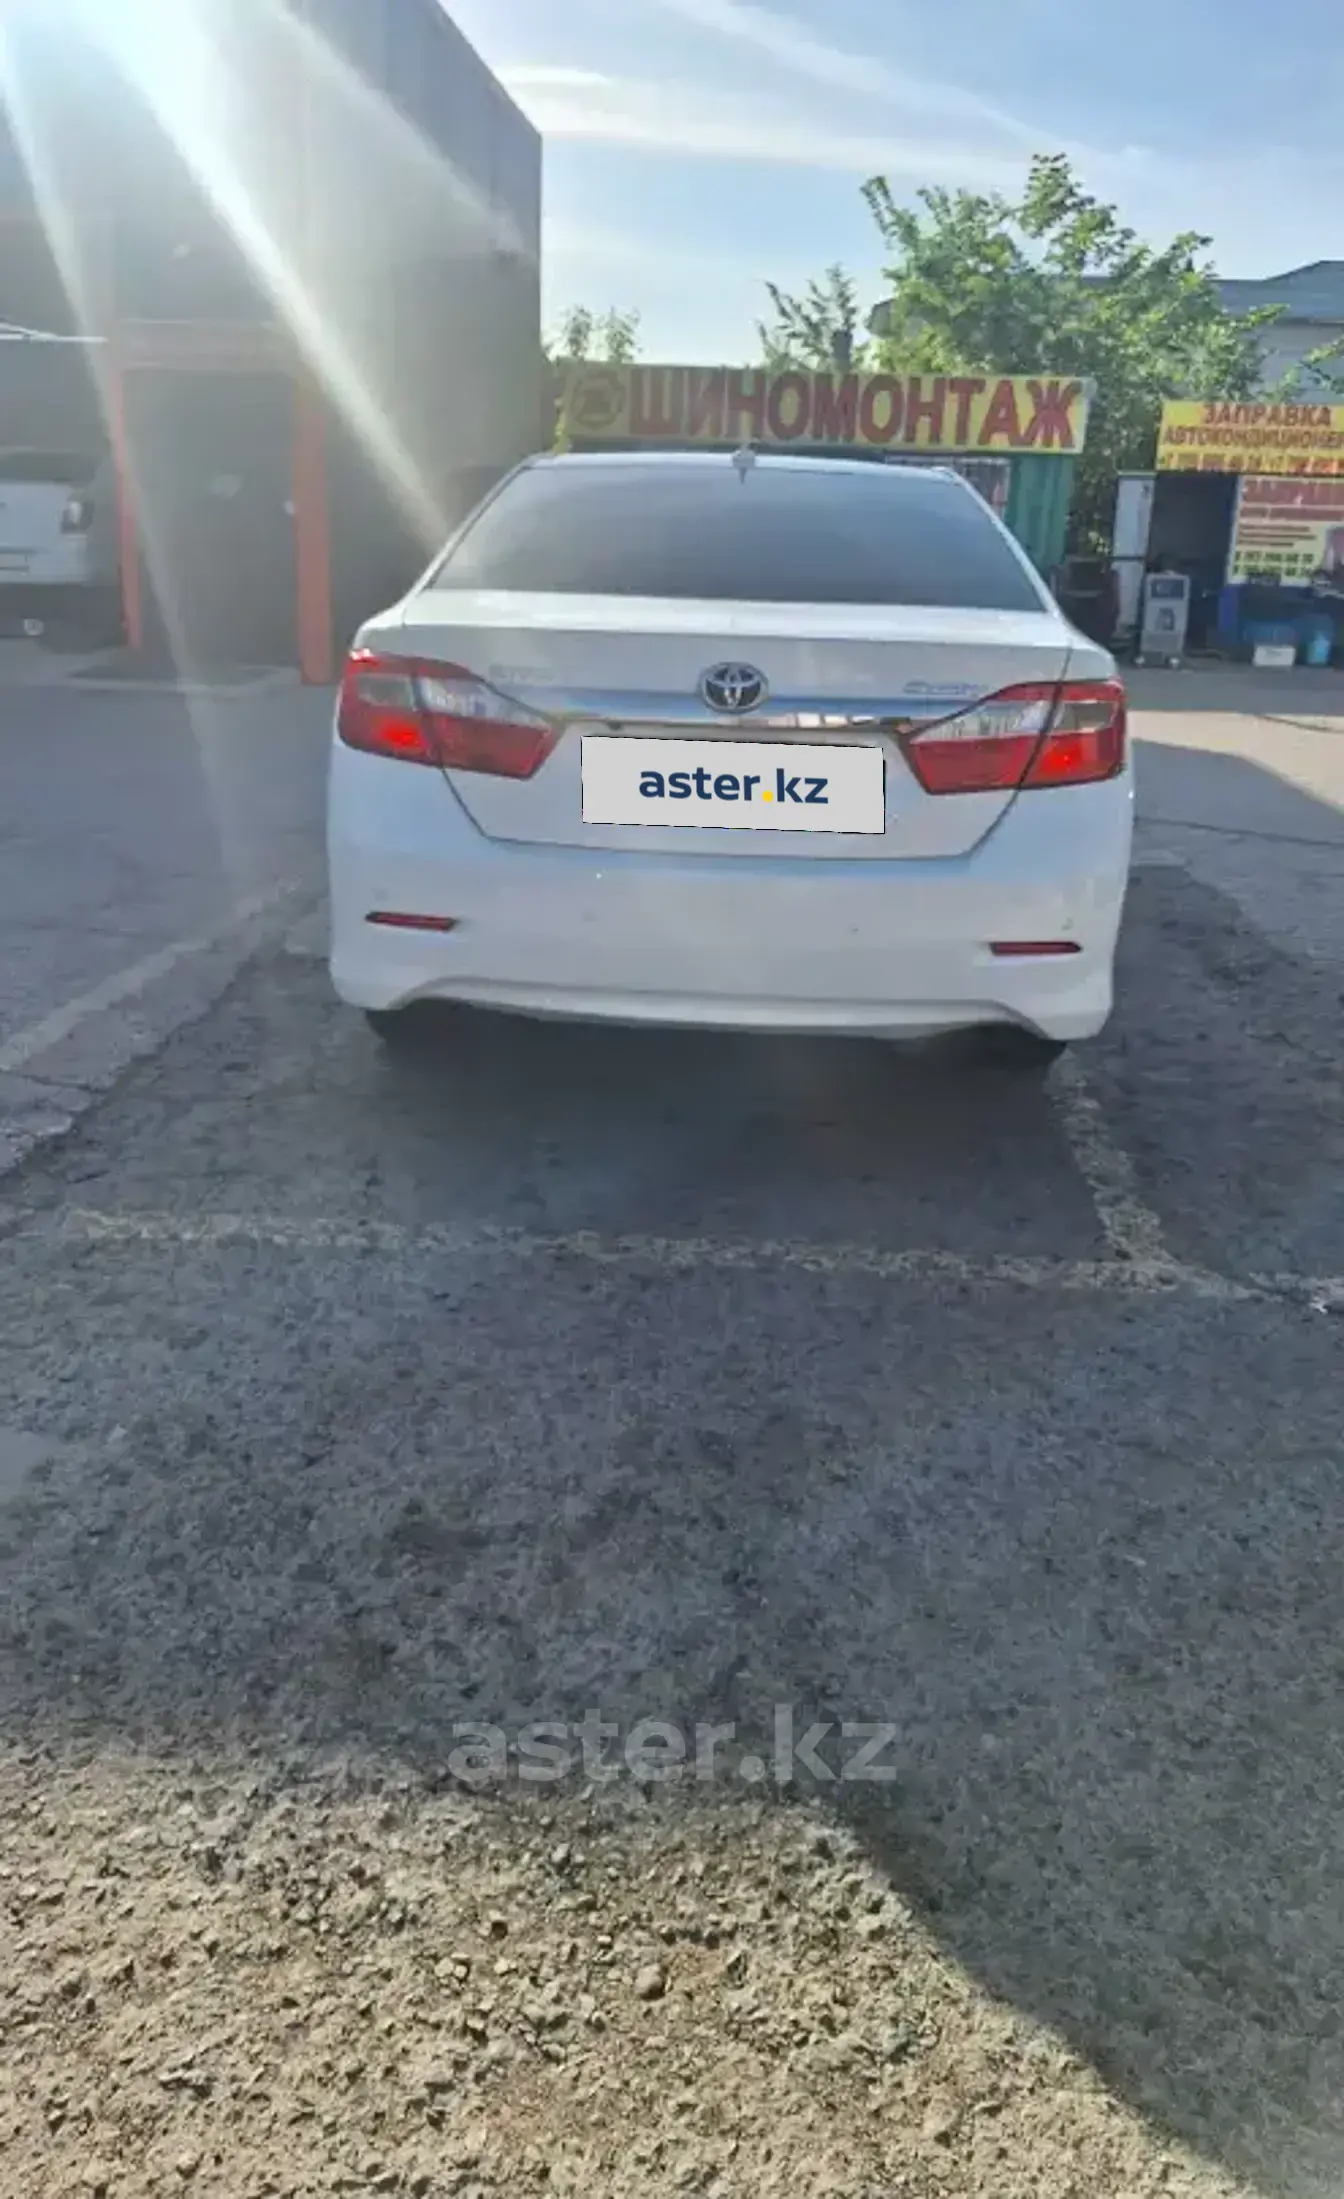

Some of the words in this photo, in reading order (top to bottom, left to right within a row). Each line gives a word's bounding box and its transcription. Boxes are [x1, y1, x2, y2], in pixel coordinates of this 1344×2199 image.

[629, 367, 1079, 448] ШИНОМОНТАЖ
[1203, 403, 1331, 426] ЗАПРАВКА
[1165, 426, 1344, 449] АВТОКОНДИЦИОНЕ
